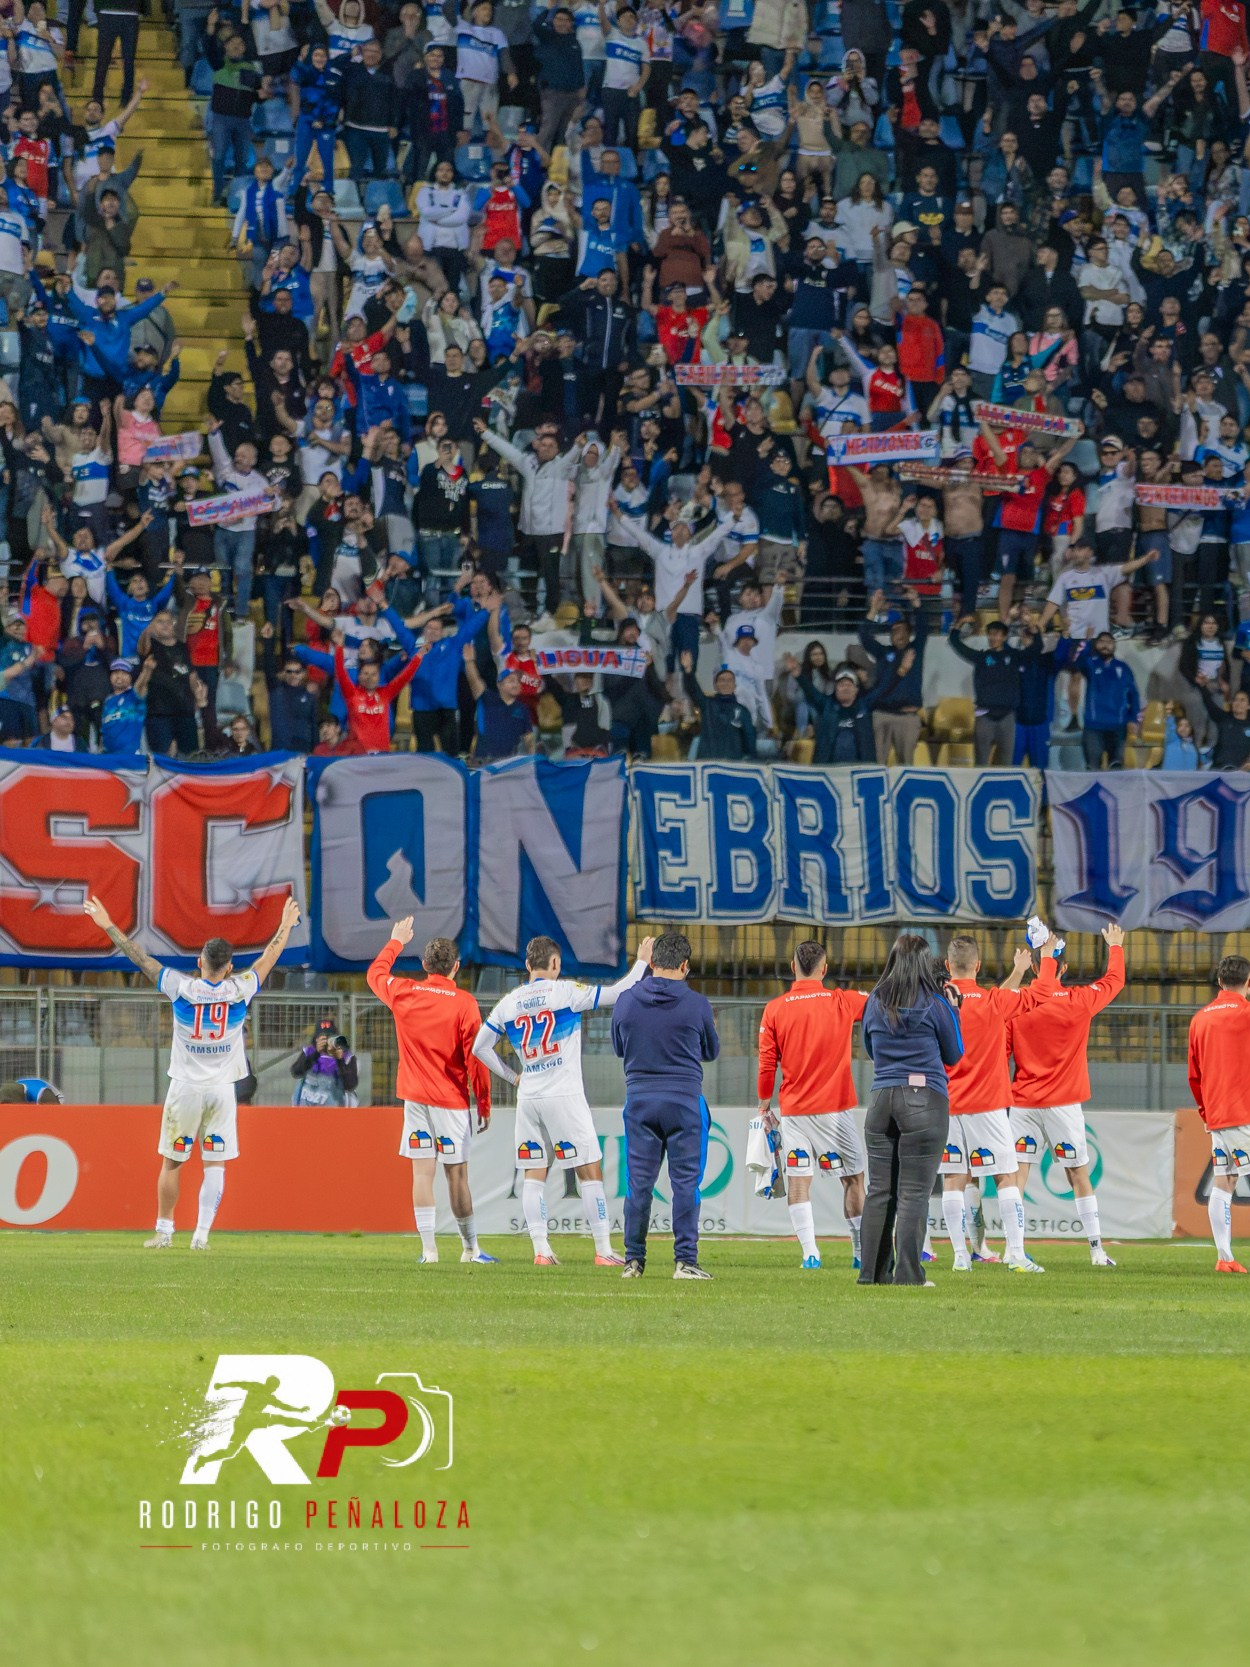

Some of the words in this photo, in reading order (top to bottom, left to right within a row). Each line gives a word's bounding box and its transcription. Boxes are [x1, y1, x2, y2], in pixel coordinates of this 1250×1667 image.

[633, 764, 1037, 921] EBRIOS
[785, 992, 832, 1003] LEAPMOTOR
[189, 1002, 229, 1041] 19
[514, 1008, 559, 1060] 22
[185, 1044, 231, 1054] SAMSUNG
